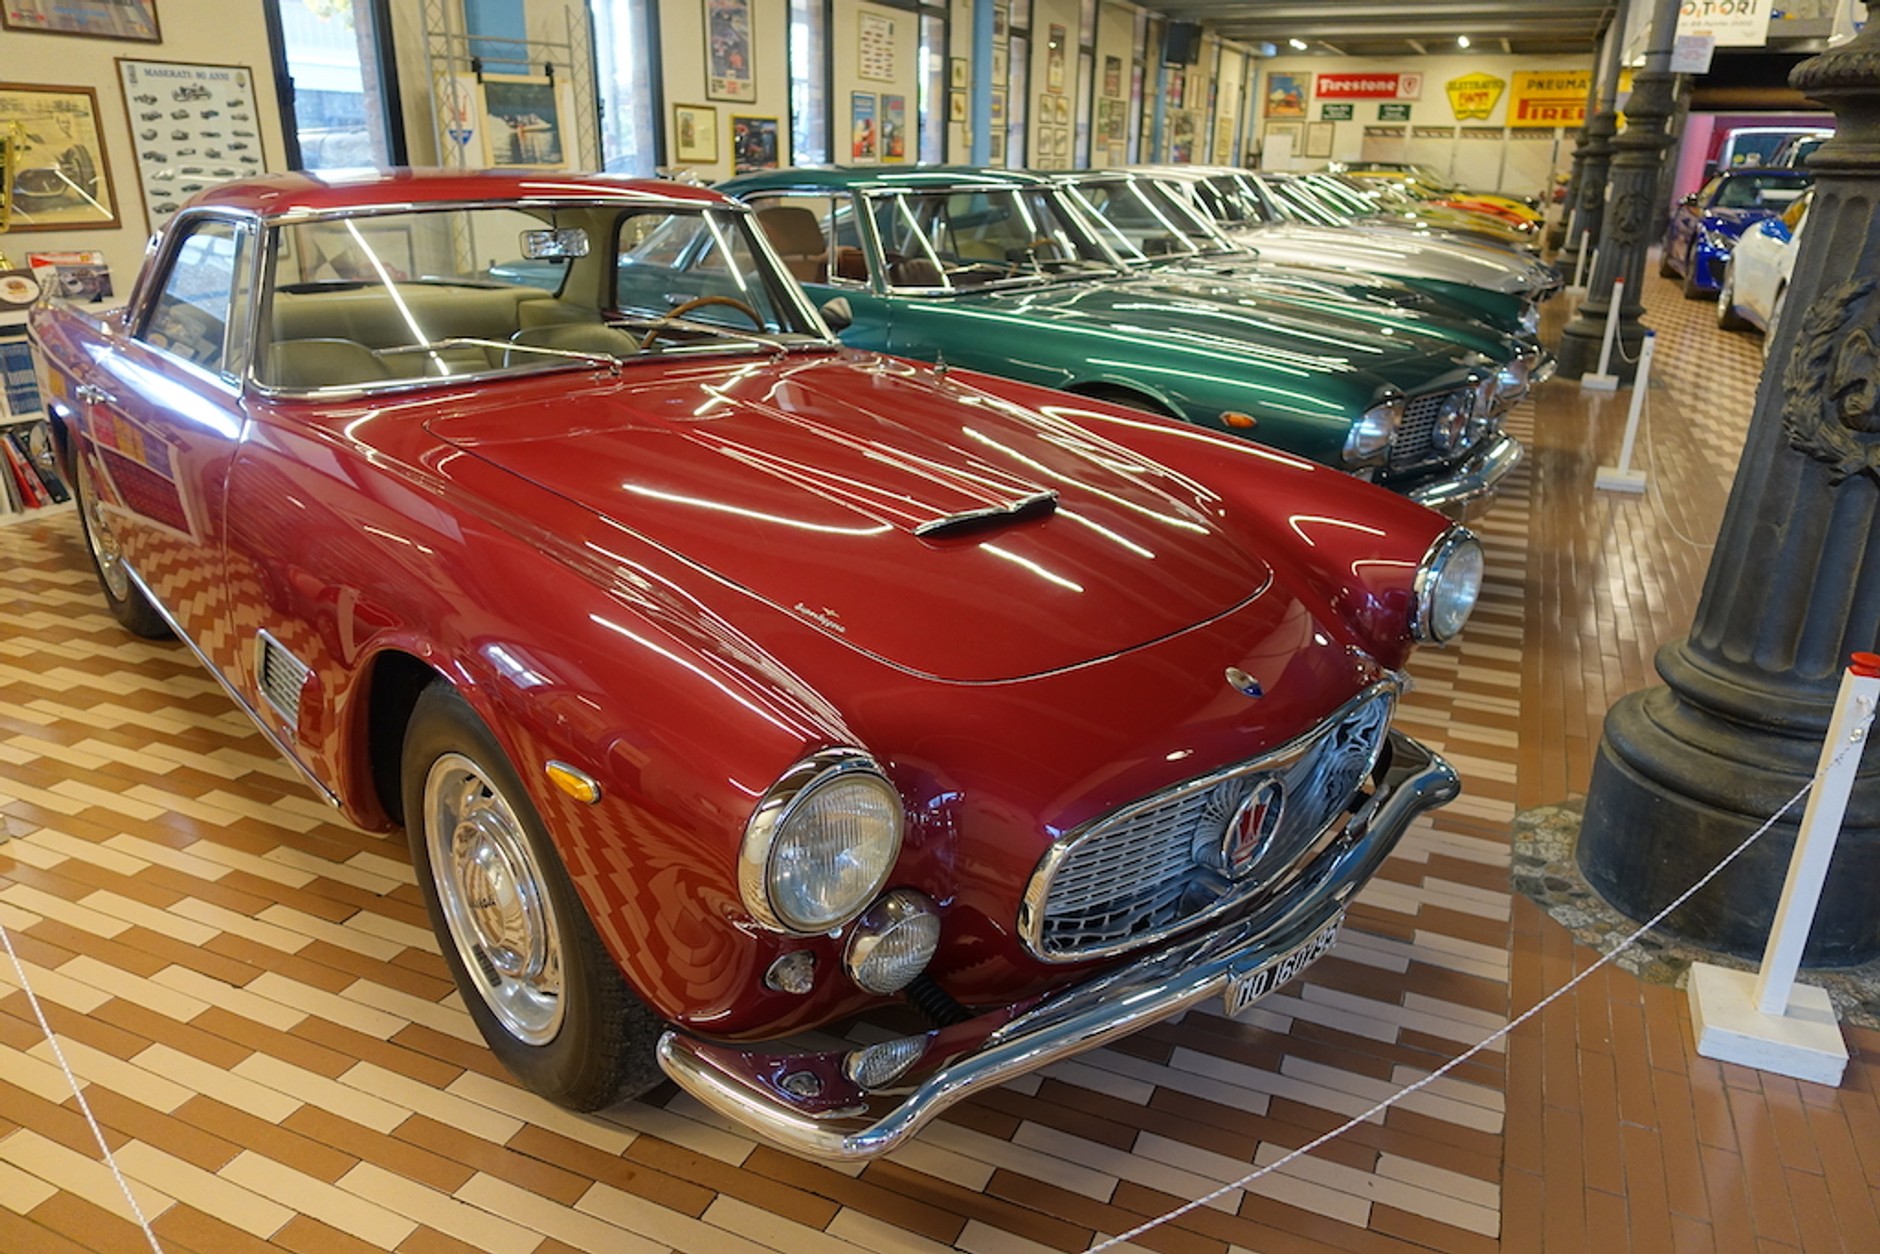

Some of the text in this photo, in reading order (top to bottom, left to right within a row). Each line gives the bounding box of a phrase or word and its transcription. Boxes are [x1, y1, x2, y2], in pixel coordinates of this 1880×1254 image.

[1320, 79, 1396, 94] Firestone
[1526, 79, 1587, 90] PNEUMA
[1517, 98, 1586, 120] PIREL
